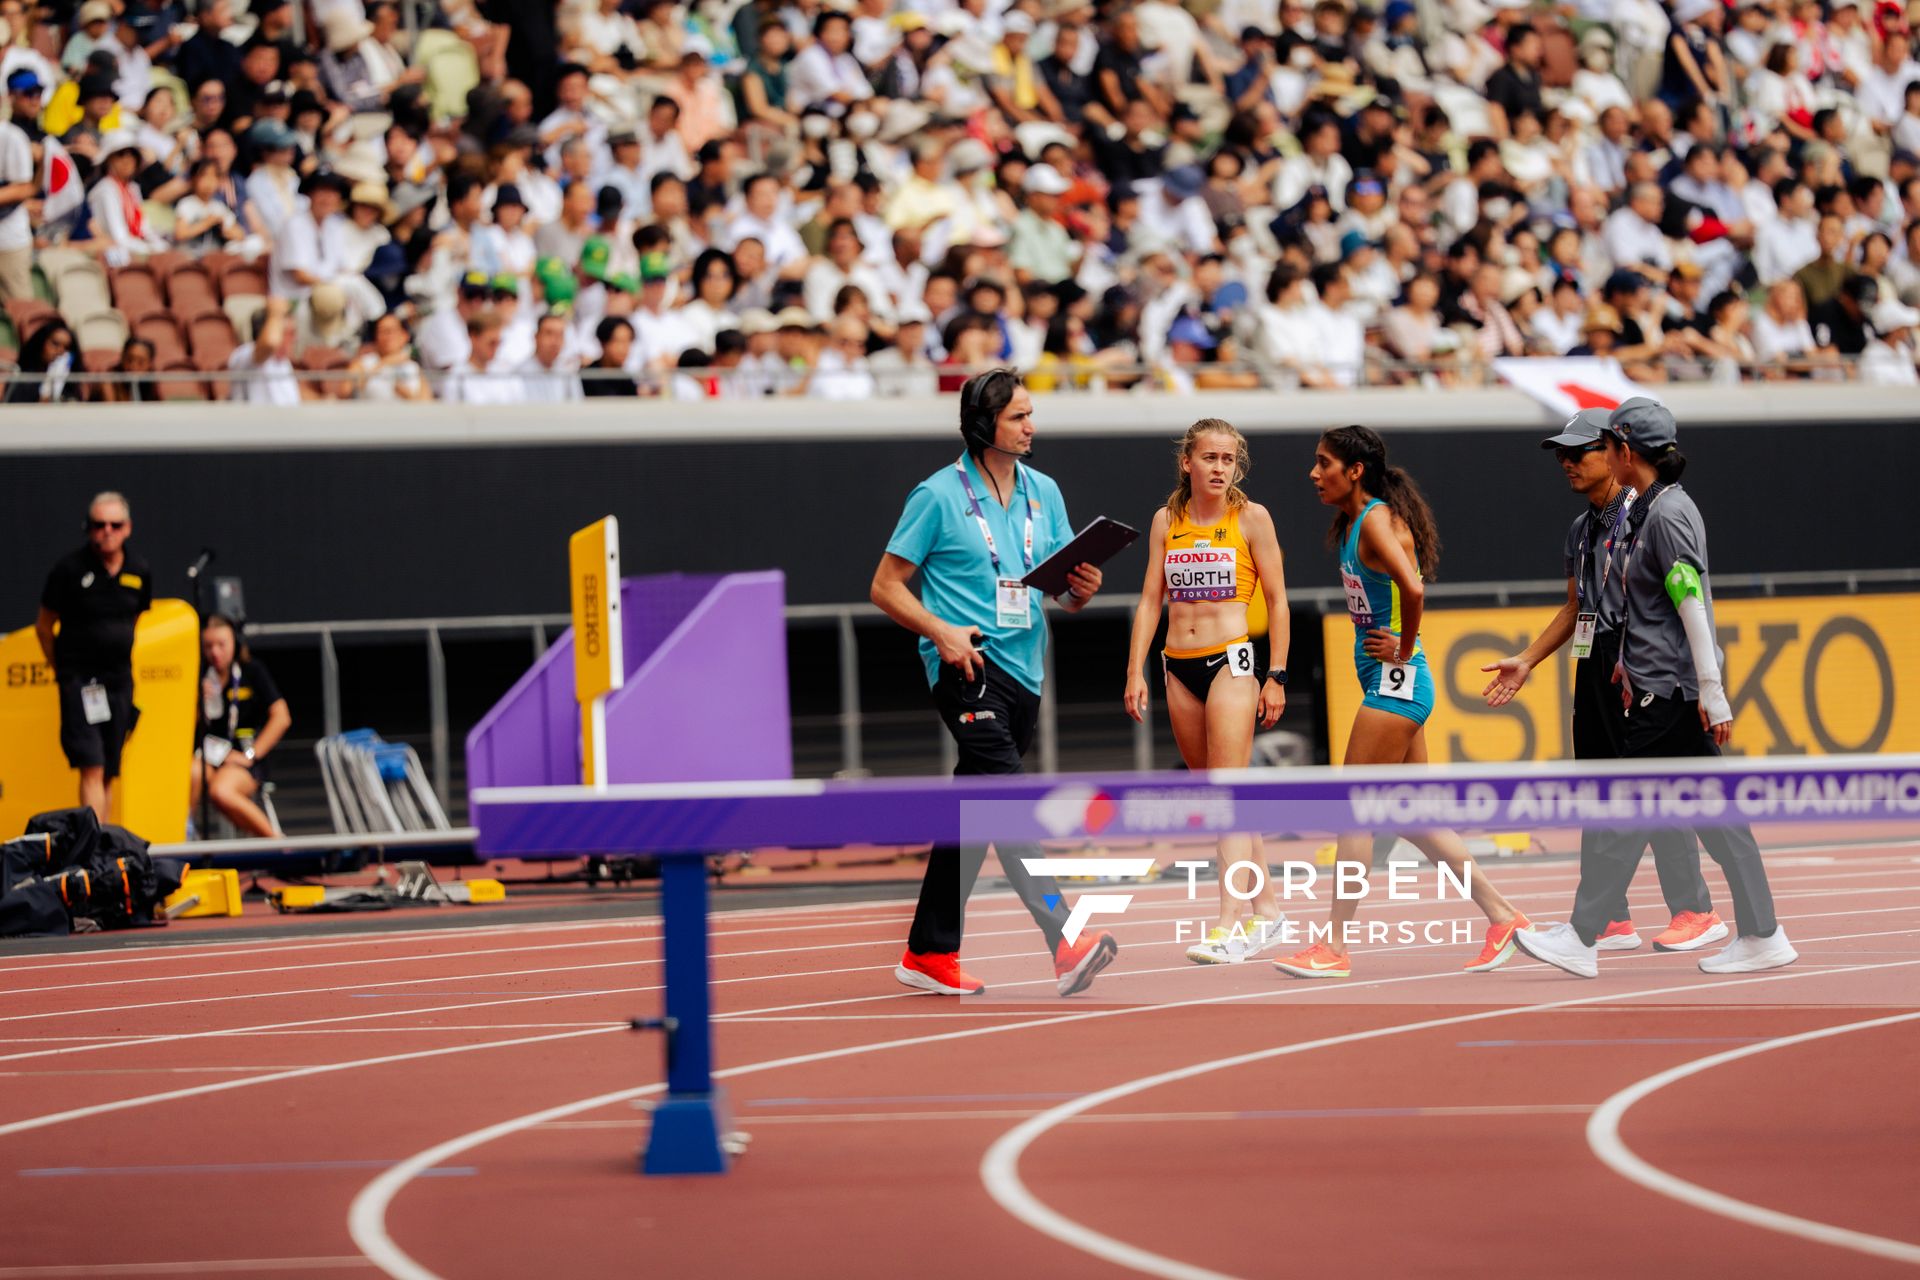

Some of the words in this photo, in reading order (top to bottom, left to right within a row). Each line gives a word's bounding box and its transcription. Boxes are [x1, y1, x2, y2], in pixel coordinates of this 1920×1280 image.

[1167, 552, 1233, 564] HONDA
[1170, 569, 1231, 586] GÜRTH
[583, 573, 600, 658] SEIKO
[1238, 647, 1250, 672] 8
[1389, 667, 1405, 691] 9
[1445, 616, 1894, 763] SKO
[1349, 783, 1497, 824] WORLD
[1508, 777, 1727, 820] ATHLETICS
